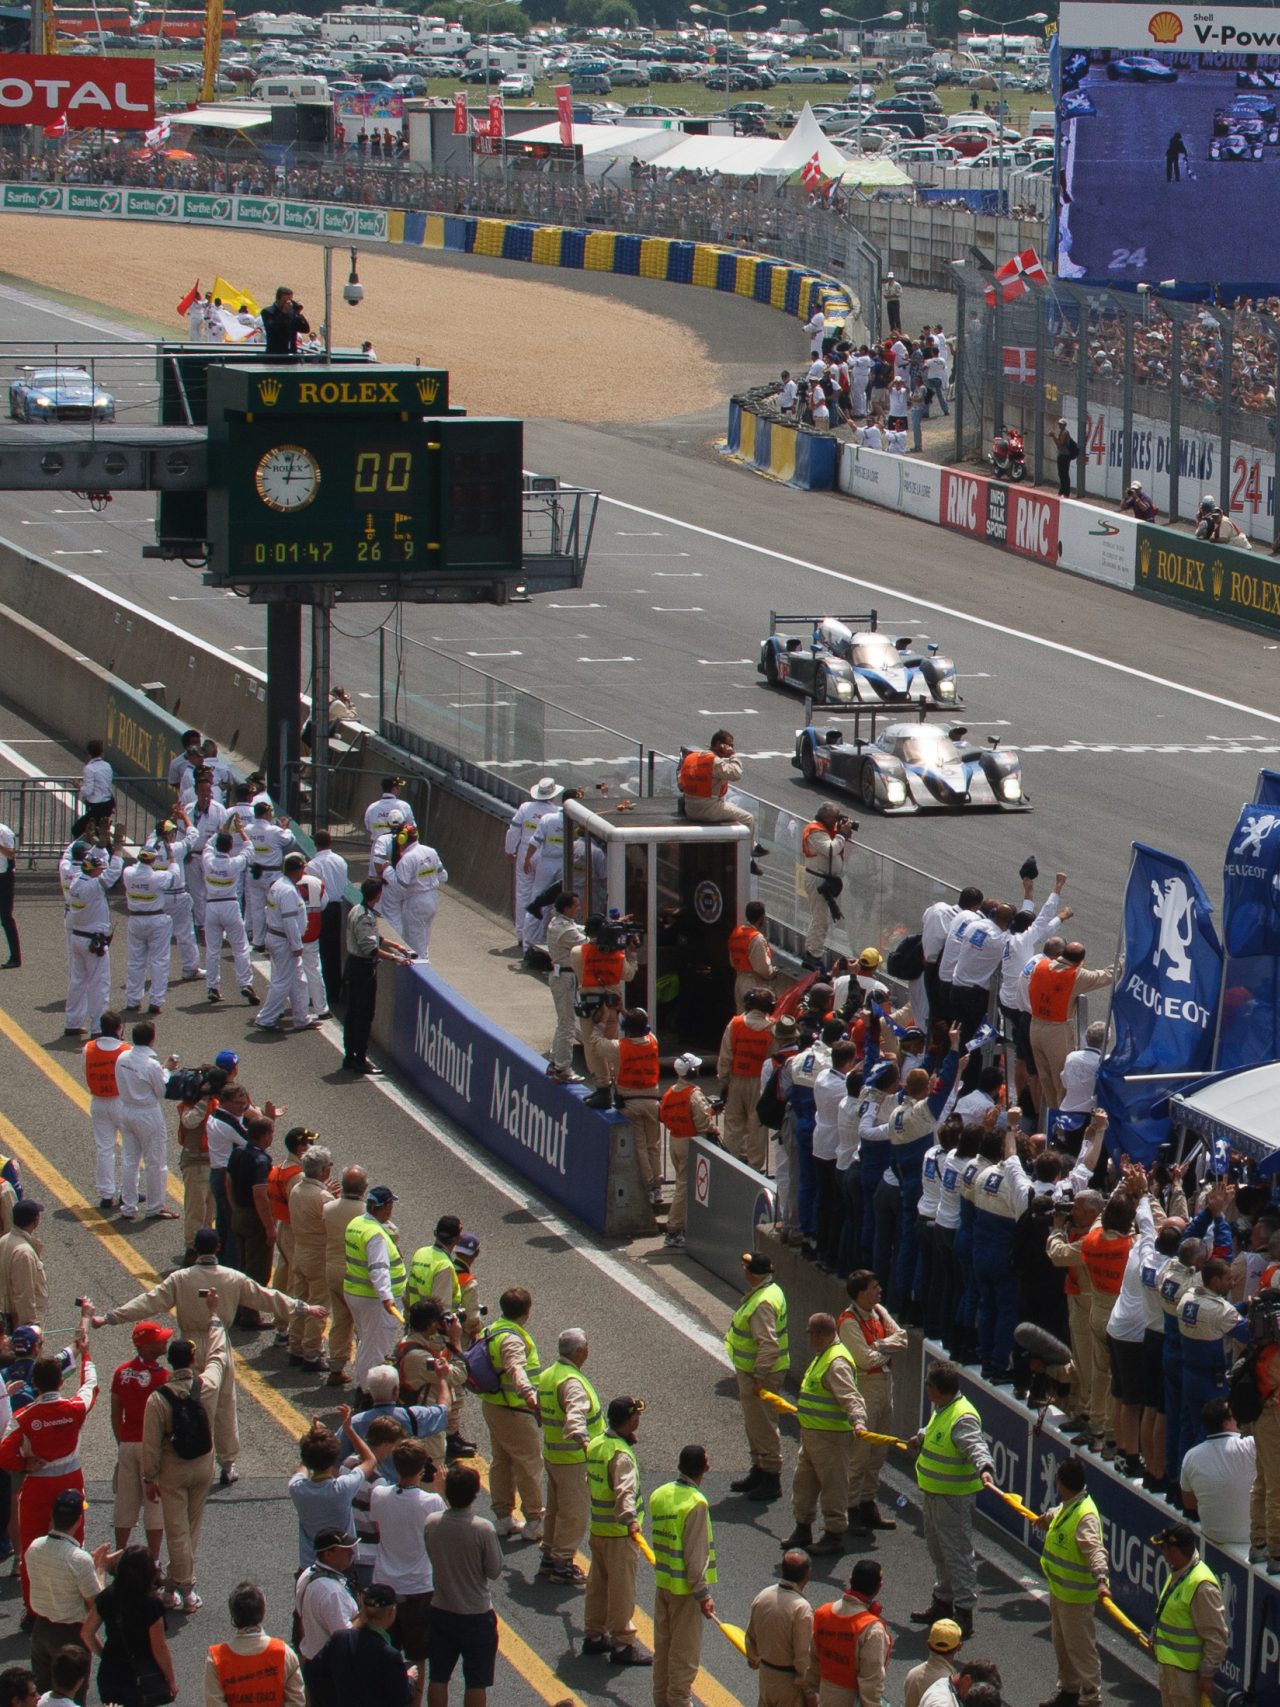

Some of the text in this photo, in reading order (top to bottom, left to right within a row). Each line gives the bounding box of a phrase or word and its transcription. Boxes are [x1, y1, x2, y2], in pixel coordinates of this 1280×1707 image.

[1194, 14, 1214, 22] Shell
[8, 191, 36, 204] Sarthe
[71, 194, 99, 208] Sarthe
[129, 198, 156, 212] Sarthe
[187, 201, 211, 214] Sarthe
[240, 205, 262, 219] Sarthe
[1107, 247, 1147, 269] 24
[299, 383, 400, 403] ROLEX
[1110, 429, 1152, 471] HERES
[1179, 438, 1213, 480] MANS
[272, 464, 304, 473] ROLEX
[354, 452, 413, 493] 00
[1230, 455, 1263, 514] 24
[947, 475, 978, 530] RMC
[990, 488, 1005, 502] INFO
[989, 505, 1005, 523] TALK
[986, 519, 1007, 540] SPORT
[1015, 497, 1051, 556] RMC
[357, 542, 381, 561] 26
[403, 541, 415, 559] 9
[1156, 550, 1206, 592] ROLEX
[117, 711, 152, 774] ROLEX
[1223, 863, 1268, 881] PEUGEOT
[1125, 973, 1211, 1030] PEUGEOT
[414, 994, 474, 1104] Matmut
[489, 1057, 569, 1176] Matmut
[43, 1416, 74, 1428] brembo
